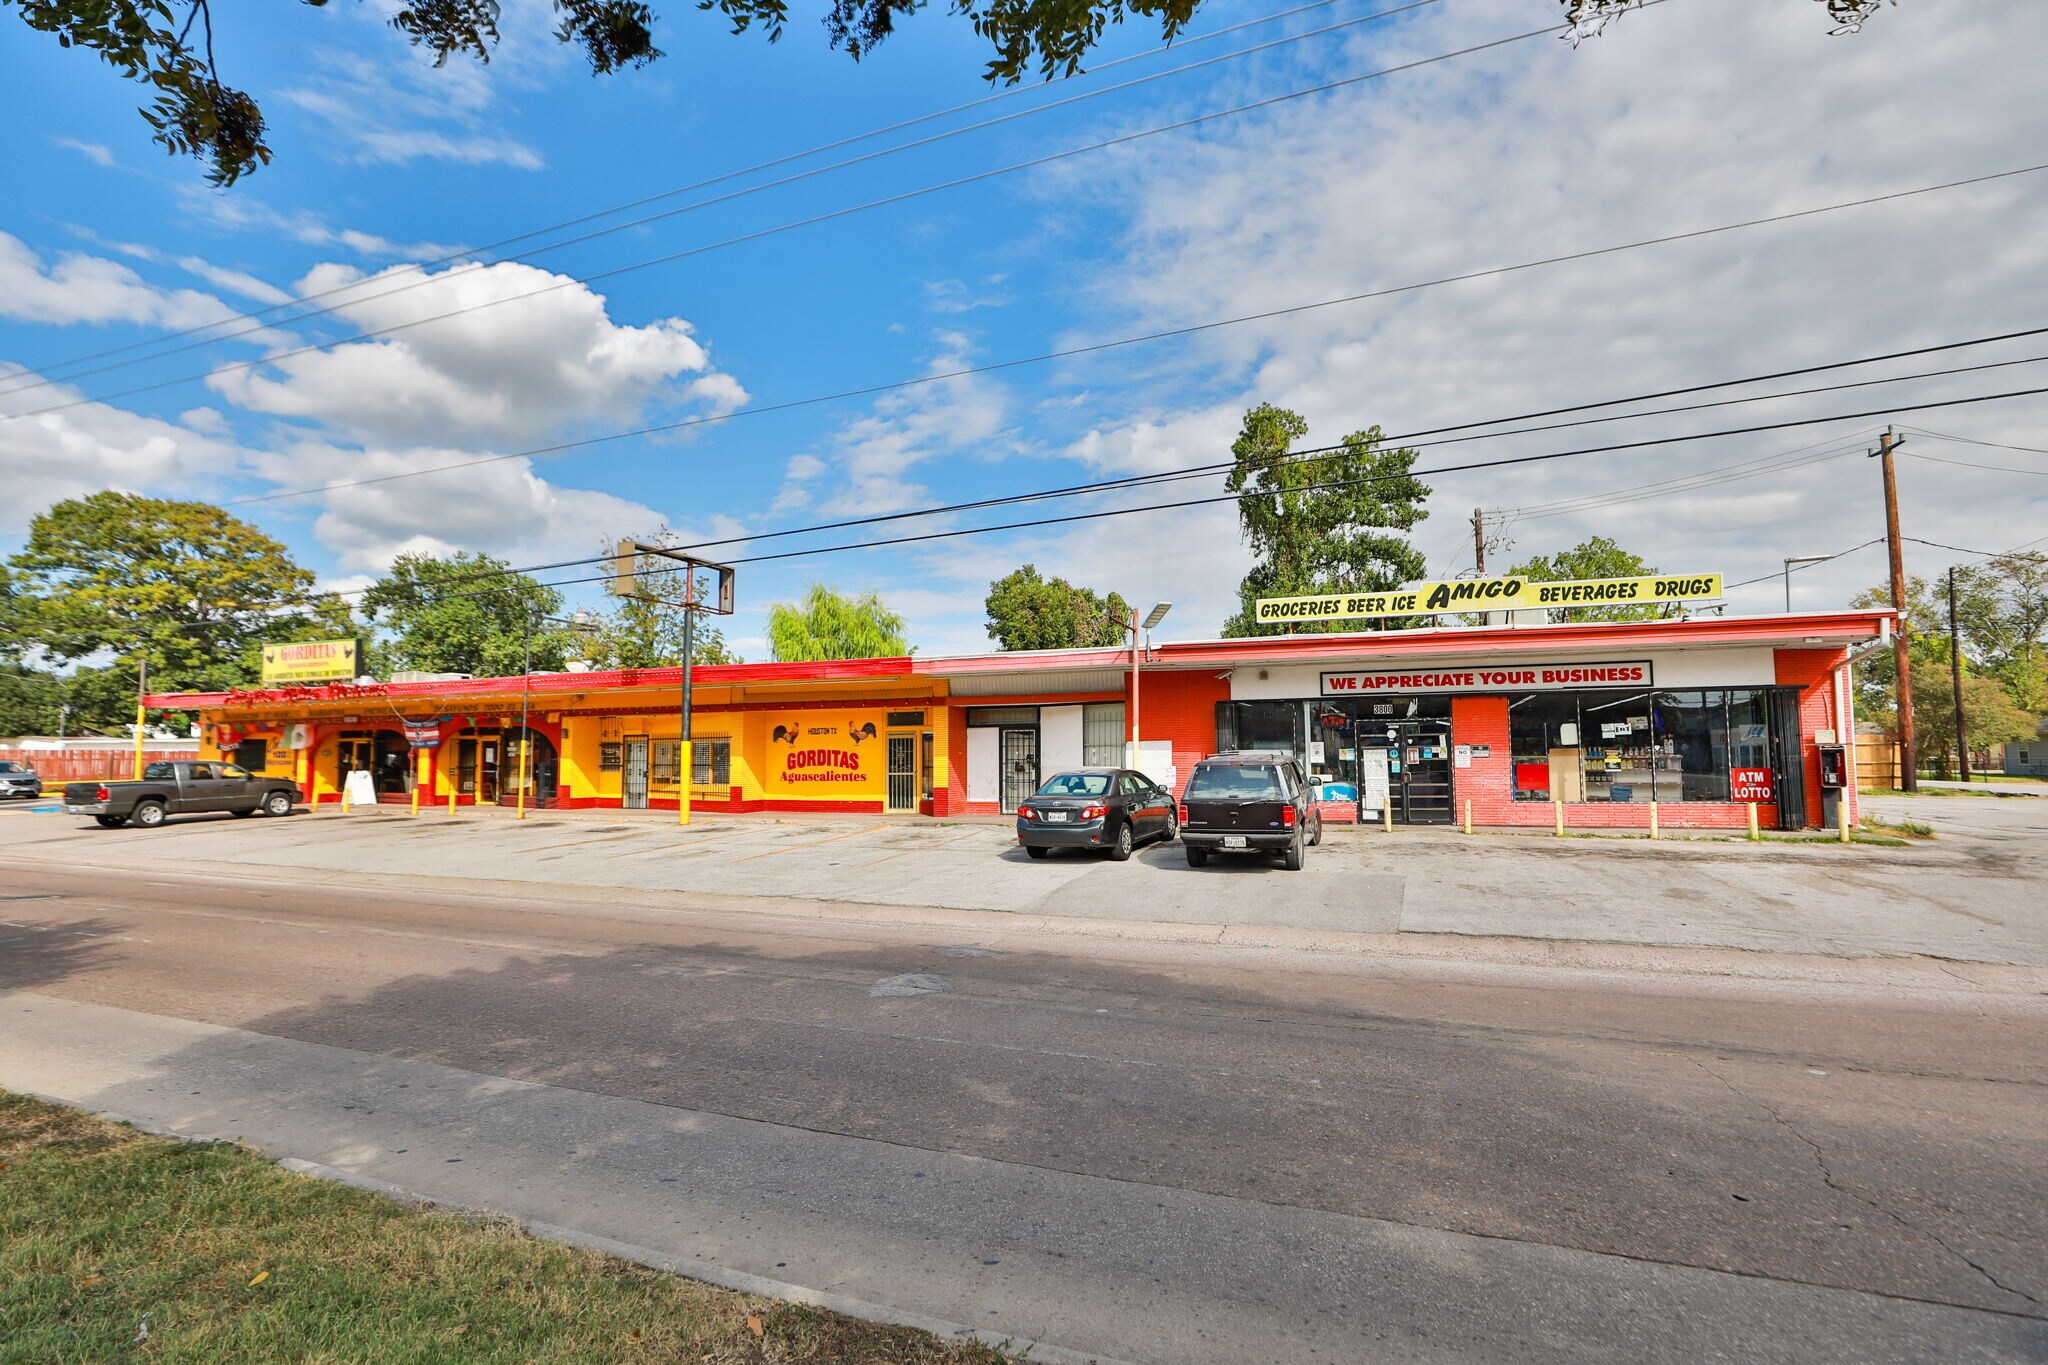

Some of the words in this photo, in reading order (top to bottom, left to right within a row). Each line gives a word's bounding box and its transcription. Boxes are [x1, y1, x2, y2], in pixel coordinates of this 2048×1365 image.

[1260, 599, 1340, 618] GROCERIES
[1347, 597, 1385, 613] BEER
[1391, 595, 1416, 611] ICE
[1426, 580, 1521, 609] AMIGO
[1539, 582, 1638, 602] BEVERAGES
[1655, 578, 1713, 597] DRUGS
[280, 643, 336, 661] GORDITAS
[1329, 677, 1357, 690] WE
[1362, 673, 1474, 689] APPRECIATE
[1479, 671, 1536, 685] YOUR
[1542, 667, 1643, 684] BUSINESS
[1374, 705, 1393, 714] 3800
[831, 727, 837, 735] TX
[787, 749, 859, 770] GORDITAS
[780, 770, 867, 784] Aguascalientes
[1738, 771, 1764, 782] ATM
[1734, 786, 1771, 799] LOTTO
